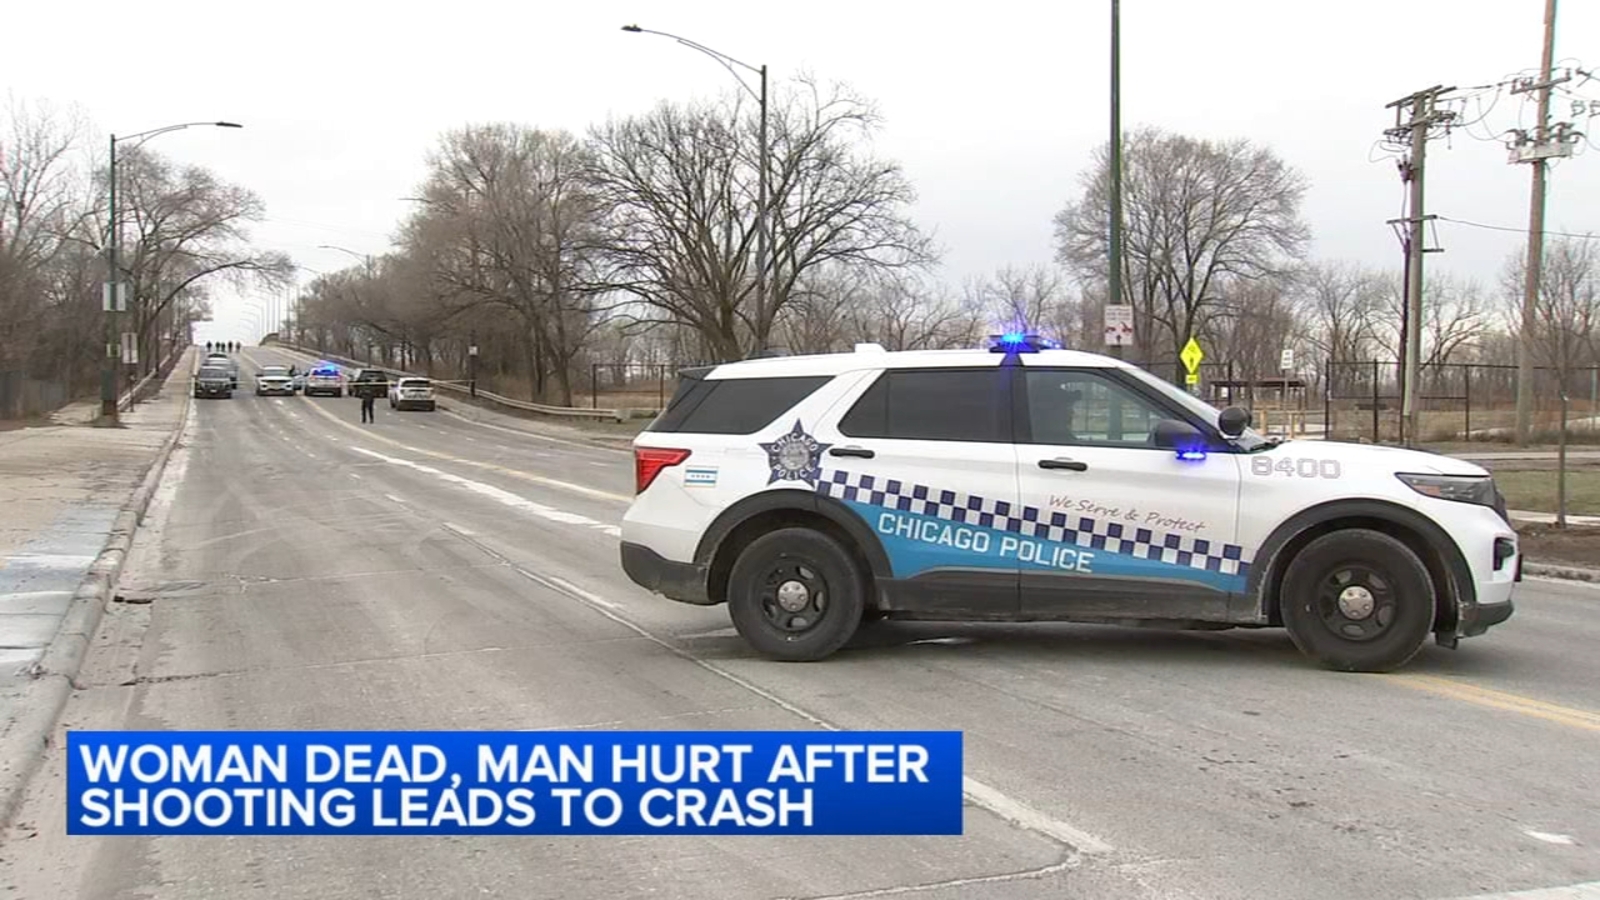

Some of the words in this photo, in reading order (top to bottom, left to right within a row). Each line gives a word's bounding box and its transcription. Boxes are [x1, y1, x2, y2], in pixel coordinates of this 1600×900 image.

[771, 432, 818, 452] CHICAGO
[773, 463, 816, 480] POLICE
[1251, 455, 1341, 479] 8400
[1049, 494, 1074, 508] We
[1075, 499, 1122, 517] Serve
[1124, 509, 1139, 522] &
[1145, 511, 1206, 533] Protect
[878, 512, 990, 553] CHICAGO
[999, 536, 1096, 574] POLICE
